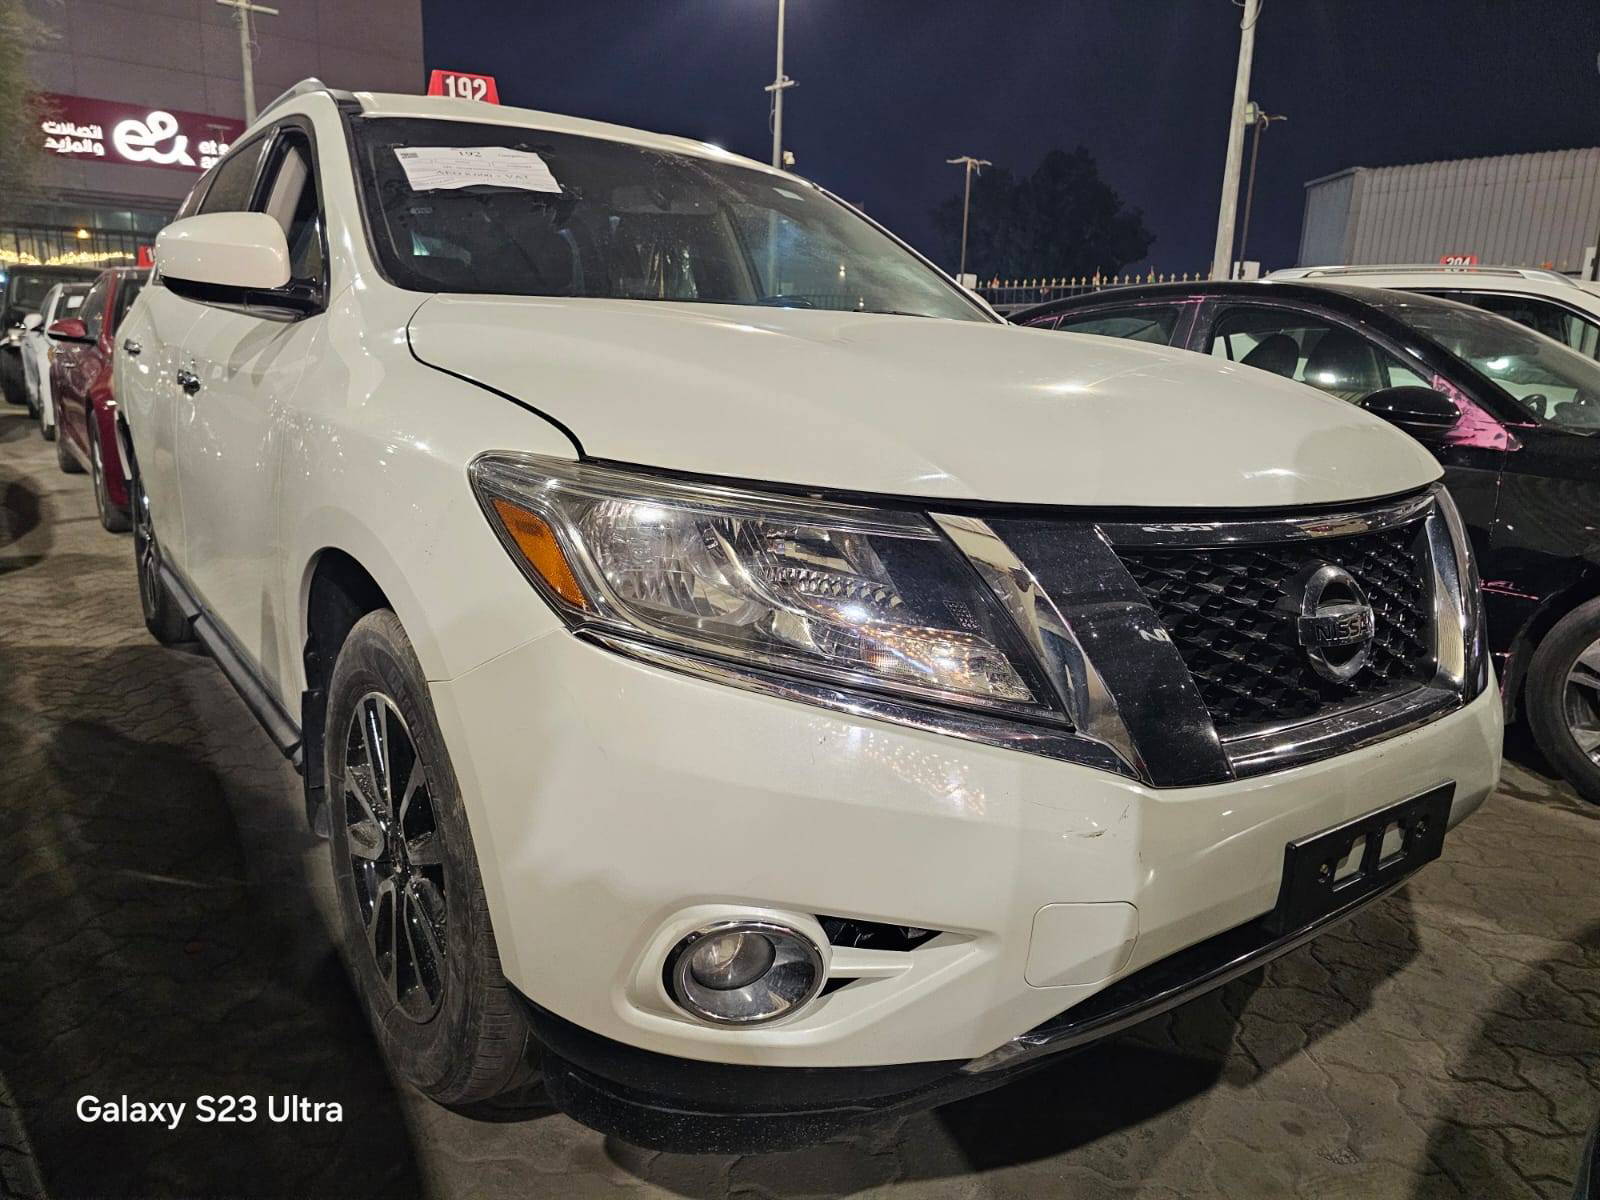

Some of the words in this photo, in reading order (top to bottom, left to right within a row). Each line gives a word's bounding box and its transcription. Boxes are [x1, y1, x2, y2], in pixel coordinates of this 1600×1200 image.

[445, 75, 487, 102] 192
[41, 121, 104, 139] اتصالات
[458, 151, 482, 159] 192
